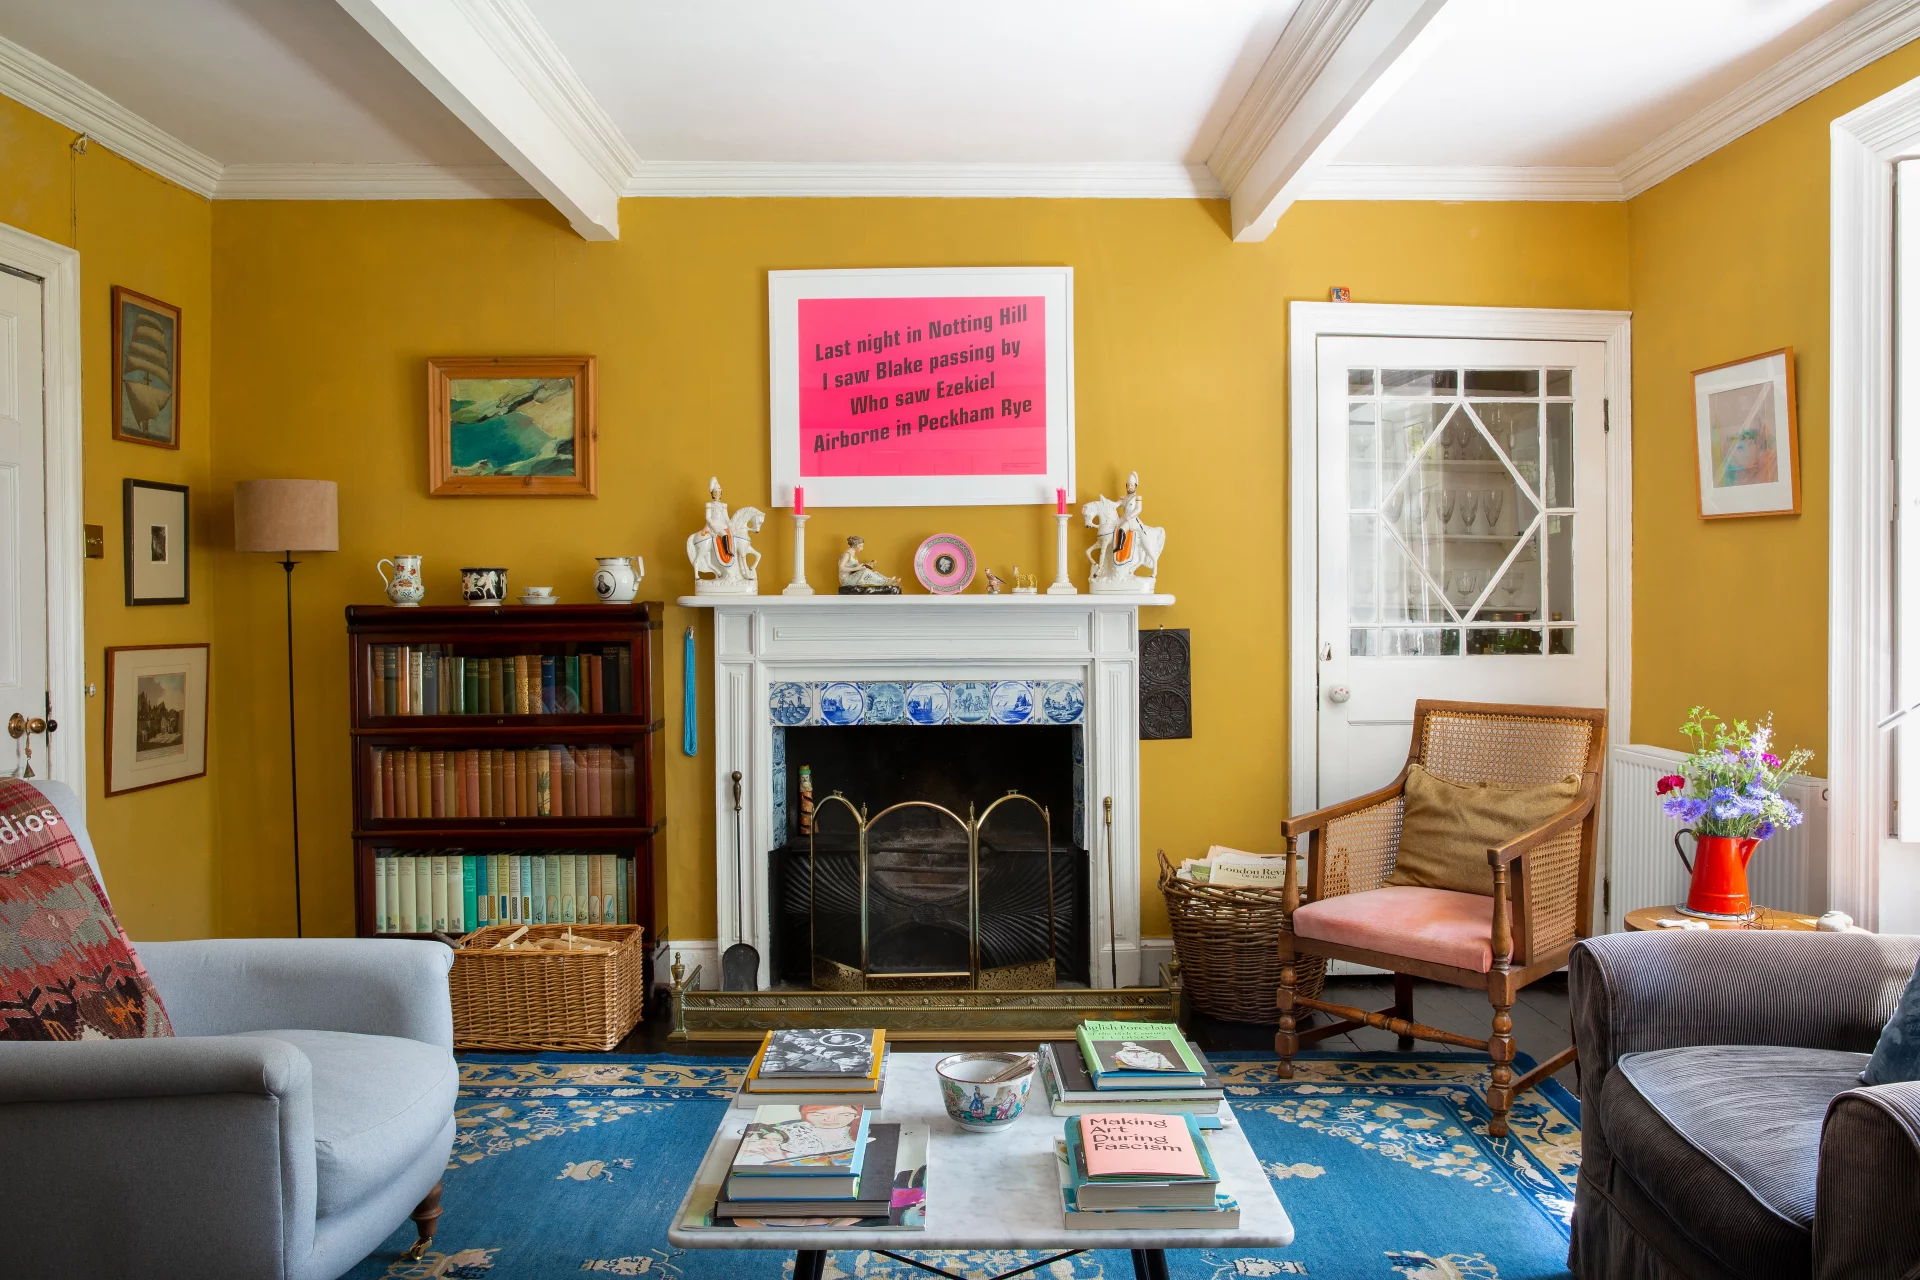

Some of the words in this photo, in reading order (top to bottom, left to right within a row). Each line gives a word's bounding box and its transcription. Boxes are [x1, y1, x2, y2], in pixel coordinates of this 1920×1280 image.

[815, 339, 851, 362] Last
[857, 330, 901, 355] night
[907, 326, 922, 344] in
[928, 314, 993, 340] Notting
[999, 303, 1028, 326] Hill
[822, 372, 828, 391] I
[834, 369, 870, 389] saw
[876, 357, 923, 381] Blake
[929, 344, 995, 374] passing
[1001, 338, 1021, 358] by
[850, 395, 889, 416] Who
[895, 387, 931, 407] saw
[936, 371, 995, 399] Ezekiel
[813, 426, 890, 454] Airborne
[896, 420, 912, 437] in
[918, 406, 995, 433] Peckham
[1001, 398, 1032, 419] Rye
[1219, 864, 1260, 875] London
[1262, 868, 1299, 876] Revi
[1087, 1023, 1118, 1033] nglish
[1090, 1117, 1168, 1129] Making
[1090, 1126, 1129, 1135] Art
[1092, 1133, 1169, 1145] During
[1094, 1142, 1183, 1153] Fascism
